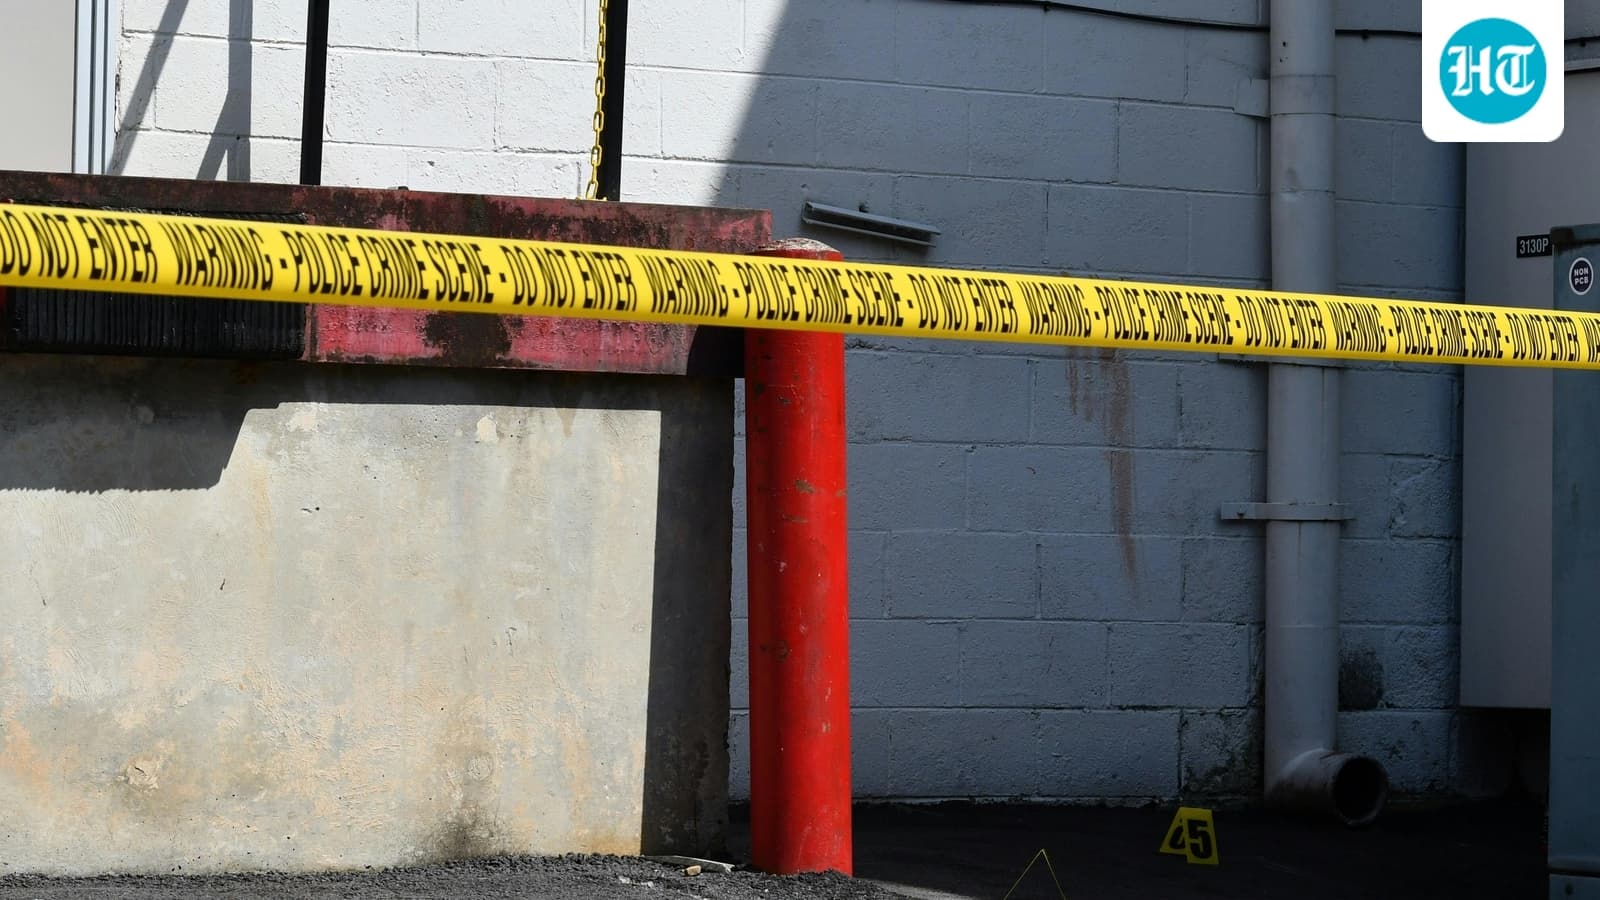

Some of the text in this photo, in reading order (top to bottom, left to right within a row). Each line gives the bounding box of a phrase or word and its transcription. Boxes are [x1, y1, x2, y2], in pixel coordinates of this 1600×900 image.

[1520, 238, 1549, 254] 3130P
[1574, 267, 1589, 276] NON
[24, 212, 80, 279] NOT
[74, 215, 158, 284] ENTER
[159, 221, 273, 290] WARNING
[280, 231, 362, 296] POLICE
[356, 234, 429, 300] CRIME
[422, 239, 494, 304] SCENE
[499, 245, 538, 306] DO
[530, 248, 576, 308] NOT
[571, 250, 637, 312] ENTER
[636, 254, 729, 318] WARNING
[732, 262, 799, 321] POLICE
[793, 265, 852, 324] CRIME
[846, 269, 904, 327] SCENE
[907, 273, 938, 330] DO
[931, 276, 969, 331] NOT
[964, 277, 1018, 334] ENTER
[1016, 280, 1091, 338] WARNING
[1094, 286, 1149, 340] POLICE
[1144, 289, 1192, 342] CRIME
[1186, 292, 1233, 345] SCENE
[1236, 296, 1260, 347] DO
[1256, 297, 1286, 348] NOT
[1282, 298, 1326, 350] ENTER
[1325, 301, 1387, 353] WARNING
[1389, 305, 1434, 355] POLICE
[1429, 308, 1469, 357] CRIME
[1464, 310, 1503, 359] SCENE
[1505, 313, 1525, 360] DO
[1521, 314, 1547, 361] NOT
[1543, 315, 1580, 362] ENTER
[1575, 277, 1589, 285] PCB
